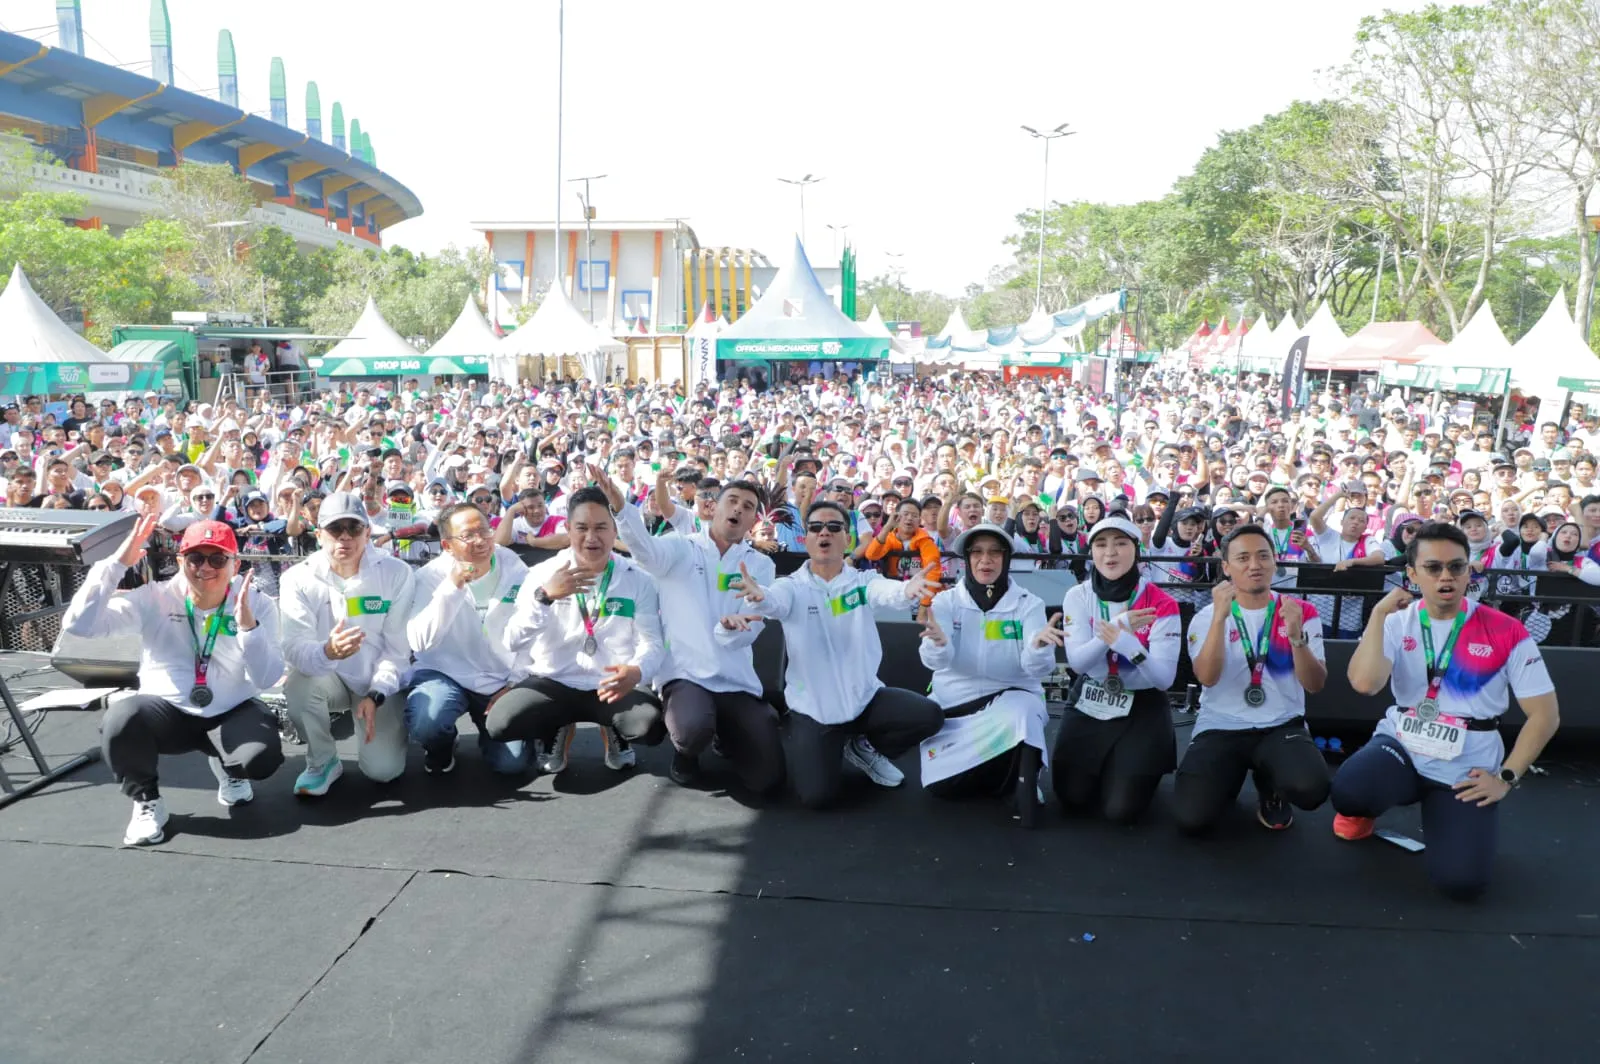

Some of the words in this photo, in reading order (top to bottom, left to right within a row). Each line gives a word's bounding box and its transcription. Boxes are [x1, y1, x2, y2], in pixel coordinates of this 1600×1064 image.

[735, 344, 766, 353] OFFICIAL
[767, 344, 819, 353] MERCHANDISE
[373, 360, 400, 370] DROP
[400, 360, 421, 370] BAG
[1085, 686, 1128, 709] BBR-012
